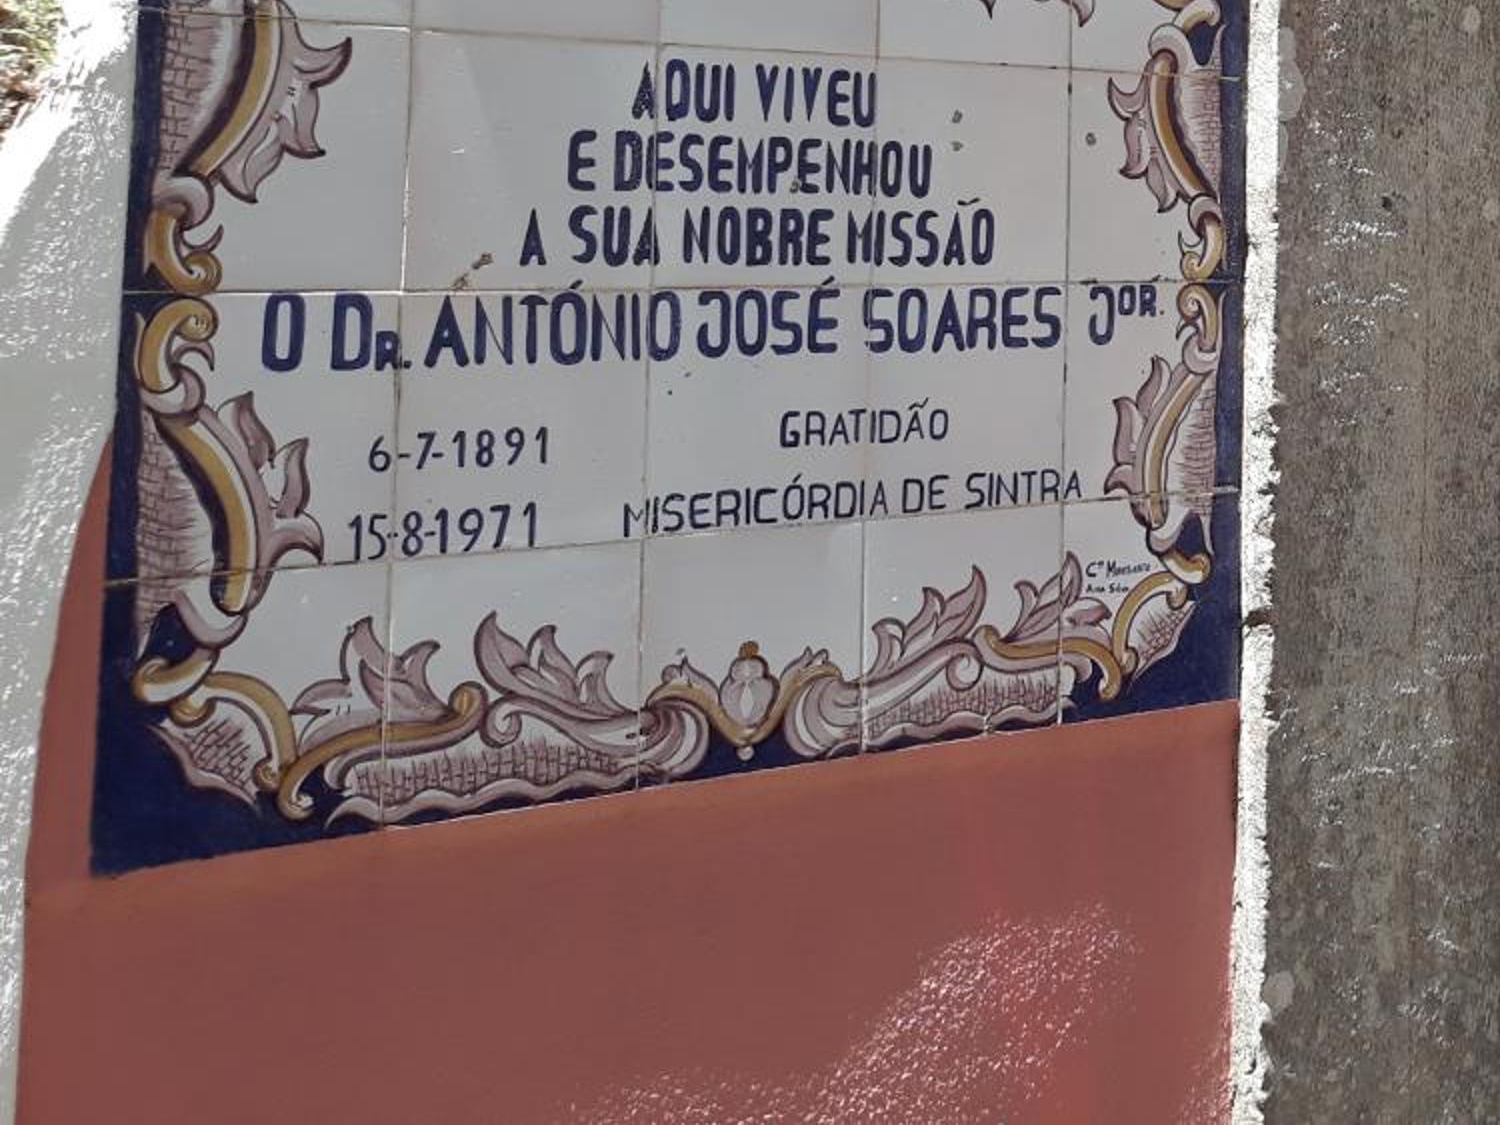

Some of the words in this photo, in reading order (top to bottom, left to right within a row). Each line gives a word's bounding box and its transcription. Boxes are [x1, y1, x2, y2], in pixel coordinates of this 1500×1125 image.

[632, 58, 735, 123] AQUI
[755, 63, 877, 128] VIVEU
[567, 129, 598, 192] E
[612, 129, 933, 199] DESEMPENHOU
[519, 207, 547, 266] A
[567, 204, 661, 267] SUA
[682, 205, 835, 267] NOBRE
[846, 196, 995, 268] MISSÃO
[261, 291, 306, 372] O
[424, 278, 682, 368] ANTÓNIO
[696, 274, 841, 358] JOSÉ
[862, 286, 1063, 354] SOARES
[368, 426, 549, 472] 6-7-1891
[778, 396, 950, 449] GRATIDÃO
[622, 471, 889, 538] MISERICÓRDIA
[901, 474, 950, 515] DE
[963, 468, 1083, 510] SINTRA
